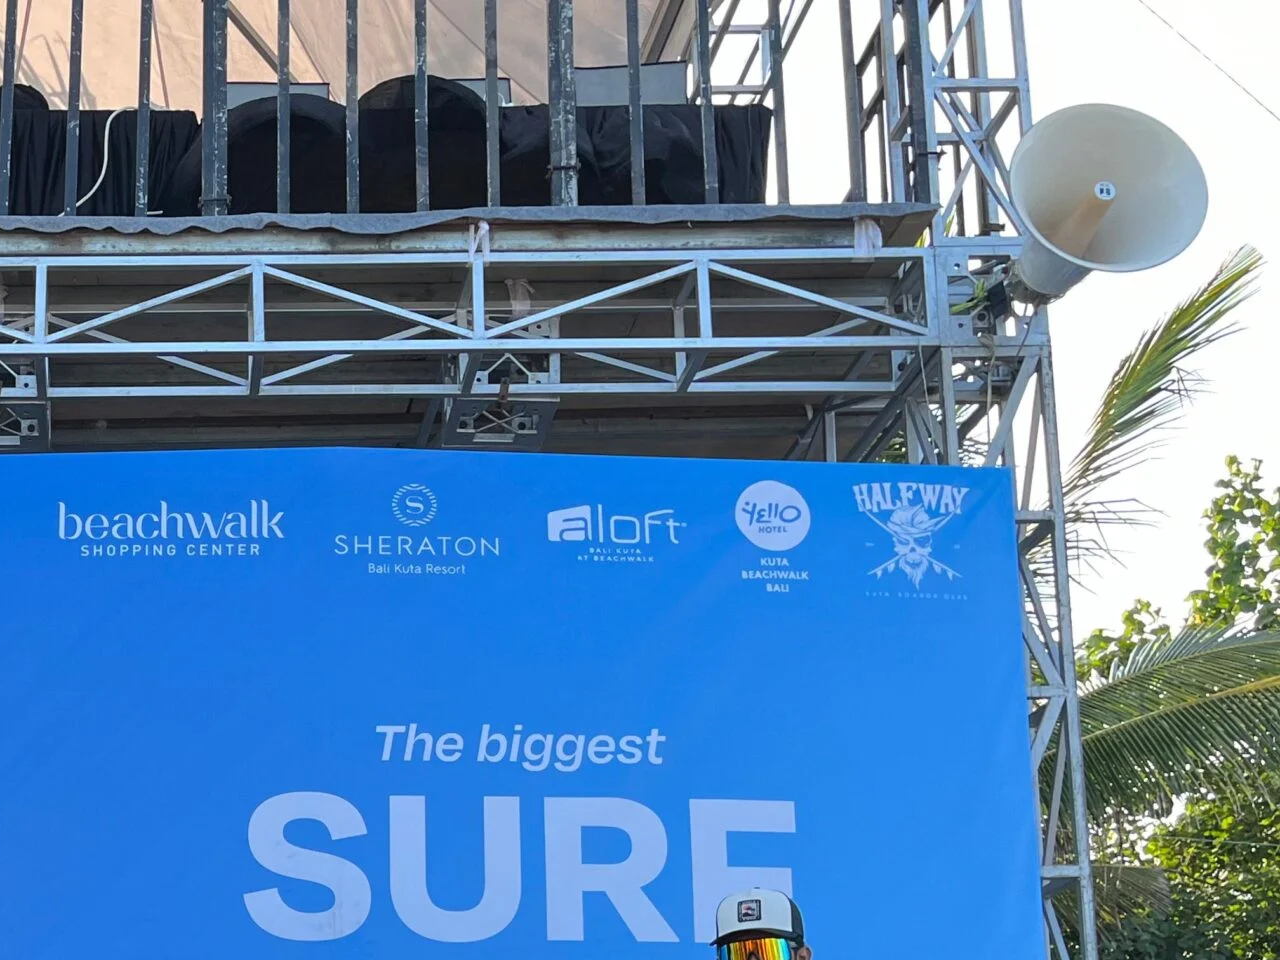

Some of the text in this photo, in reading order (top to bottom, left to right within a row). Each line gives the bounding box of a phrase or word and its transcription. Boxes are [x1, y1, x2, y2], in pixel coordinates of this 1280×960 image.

[58, 499, 285, 541] beachwalk
[758, 526, 788, 534] HOTEL
[81, 544, 261, 557] SHOPPING CENTER
[334, 534, 500, 557] SHERATON
[760, 557, 789, 567] KUTA
[368, 563, 466, 575] Bali Kuta Resort
[741, 570, 809, 581] BEACHWALK
[766, 583, 790, 592] BALI
[375, 724, 666, 772] The biggest
[243, 791, 797, 943] SURF
